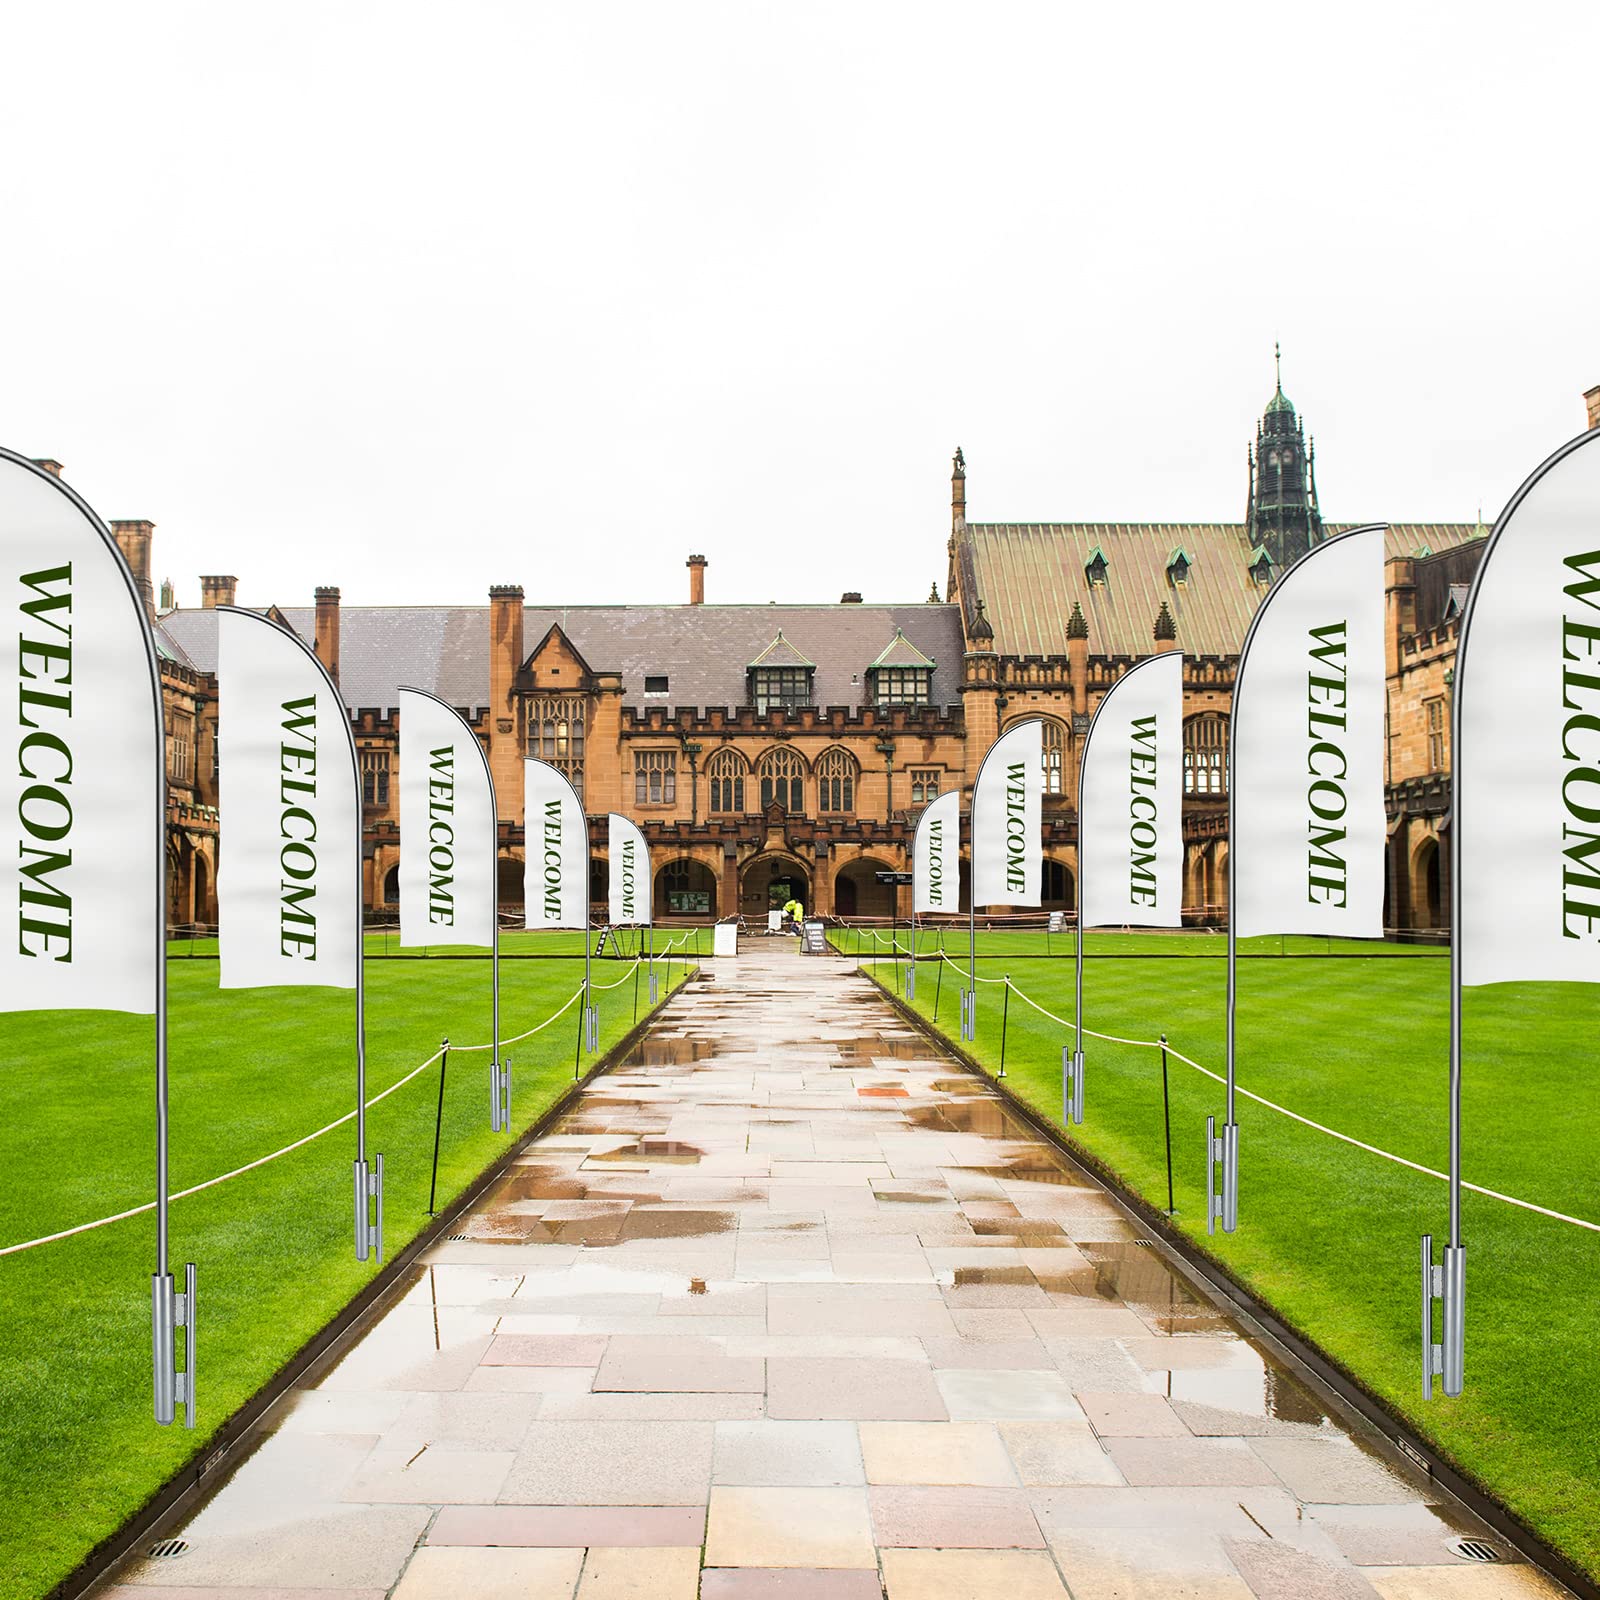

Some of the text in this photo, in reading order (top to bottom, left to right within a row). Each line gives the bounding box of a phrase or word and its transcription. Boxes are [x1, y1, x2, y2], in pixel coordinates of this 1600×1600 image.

[19, 561, 72, 963] WELCOME
[281, 694, 316, 961] WELCOME
[429, 745, 453, 926] WELCOME
[1006, 762, 1025, 893] WELCOME
[1131, 715, 1156, 907] WELCOME
[1308, 620, 1347, 908] WELCOME
[544, 800, 562, 921] WELCOME
[622, 839, 635, 918] WELCOME
[929, 819, 943, 906] WELCOME
